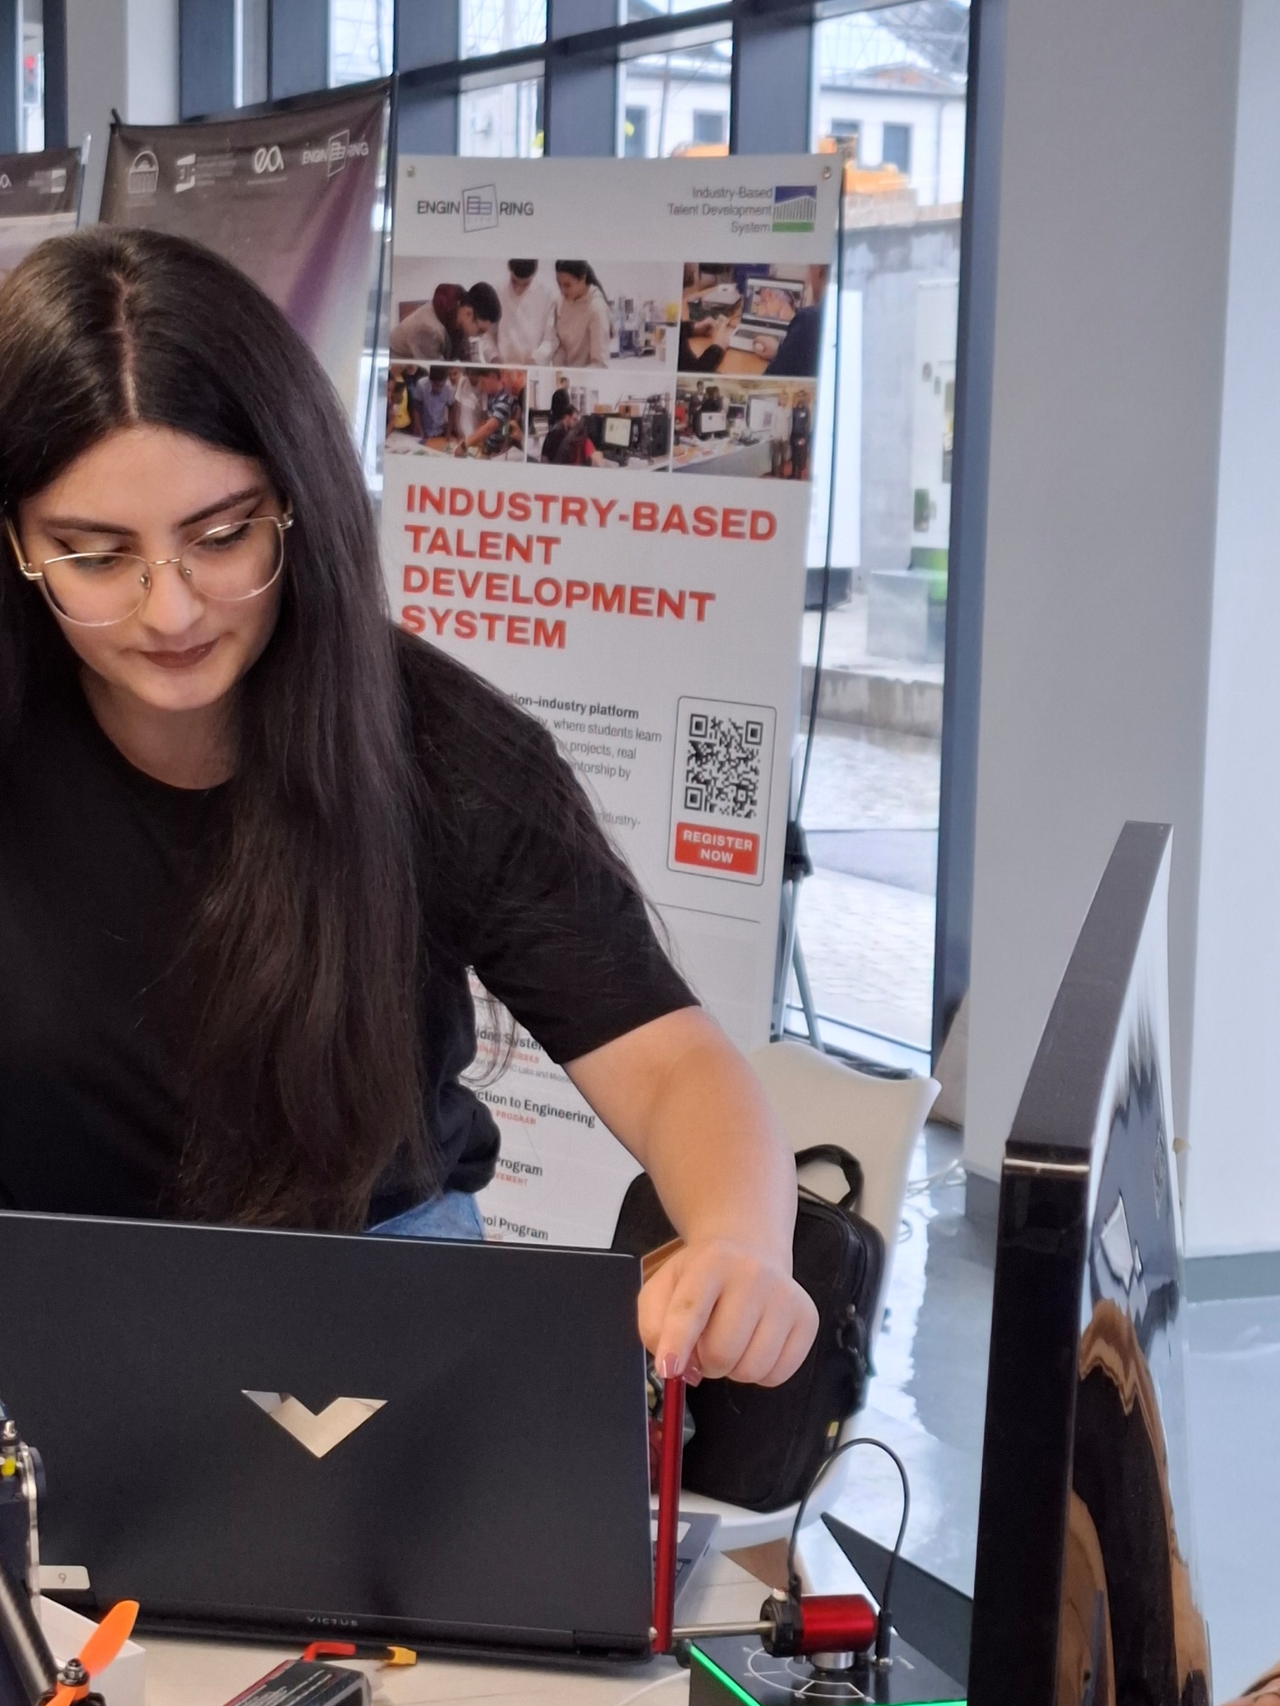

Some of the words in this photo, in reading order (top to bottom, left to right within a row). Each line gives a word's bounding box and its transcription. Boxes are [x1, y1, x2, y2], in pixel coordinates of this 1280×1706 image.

[668, 203, 698, 215] Talent
[702, 203, 771, 217] Development
[731, 221, 770, 236] System
[406, 484, 778, 541] INDUSTRY-BASED
[404, 524, 562, 565] TALENT
[403, 565, 716, 622] DEVELOPMENT
[401, 604, 567, 649] SYSTEM
[589, 703, 640, 719] platform
[553, 718, 586, 733] where
[587, 723, 634, 739] students
[635, 729, 662, 743] learn
[570, 741, 615, 758] projects,
[617, 747, 637, 760] real
[618, 765, 632, 781] by
[683, 830, 753, 851] REGISTER
[700, 848, 734, 864] NOW
[495, 1109, 537, 1125] PROGRAM
[510, 1096, 522, 1108] to
[524, 1099, 596, 1129] Engineering
[499, 1217, 549, 1241] Program
